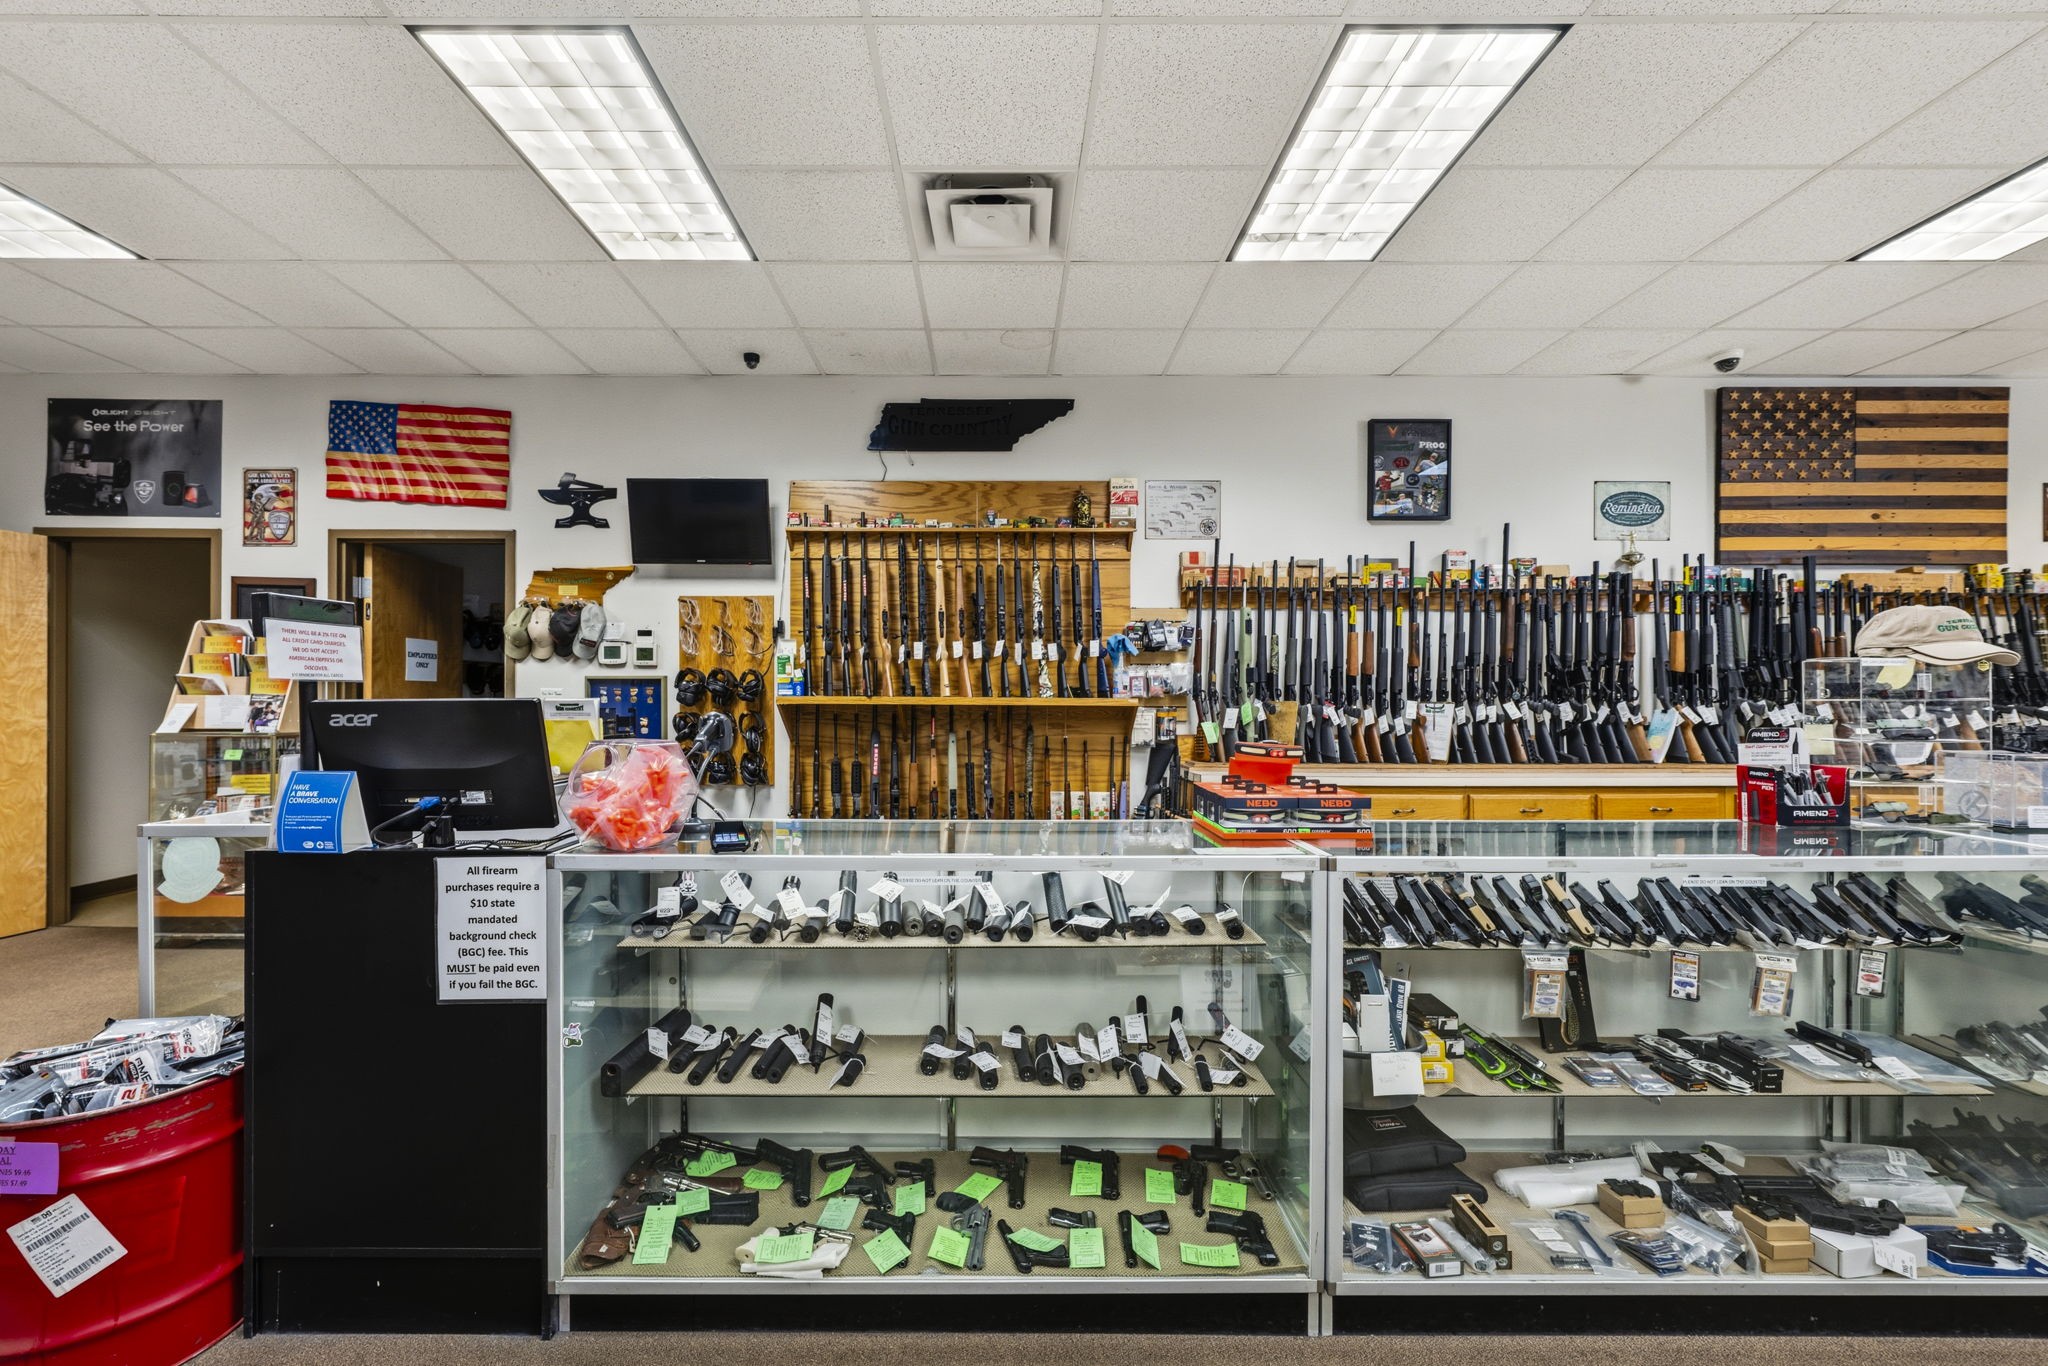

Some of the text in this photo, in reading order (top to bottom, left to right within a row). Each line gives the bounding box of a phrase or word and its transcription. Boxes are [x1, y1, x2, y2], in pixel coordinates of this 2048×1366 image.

[83, 420, 184, 432] See the Power
[888, 413, 1013, 436] GUN COUNTRY
[1603, 502, 1662, 516] Remington
[1937, 624, 1959, 632] GUN
[415, 661, 429, 669] ONLY
[329, 713, 378, 727] acer
[239, 738, 301, 750] AUTHRIZE
[466, 866, 518, 875] All firearm
[445, 883, 494, 893] purchases
[496, 882, 532, 892] require
[470, 899, 515, 909] $10 state
[468, 915, 518, 924] mandated
[449, 931, 537, 942] background check
[458, 947, 528, 958] (BGC) fee. This
[446, 964, 477, 974] MUST
[478, 964, 490, 973] be
[493, 963, 514, 974] paid
[449, 980, 538, 991] if you fail the BGC.
